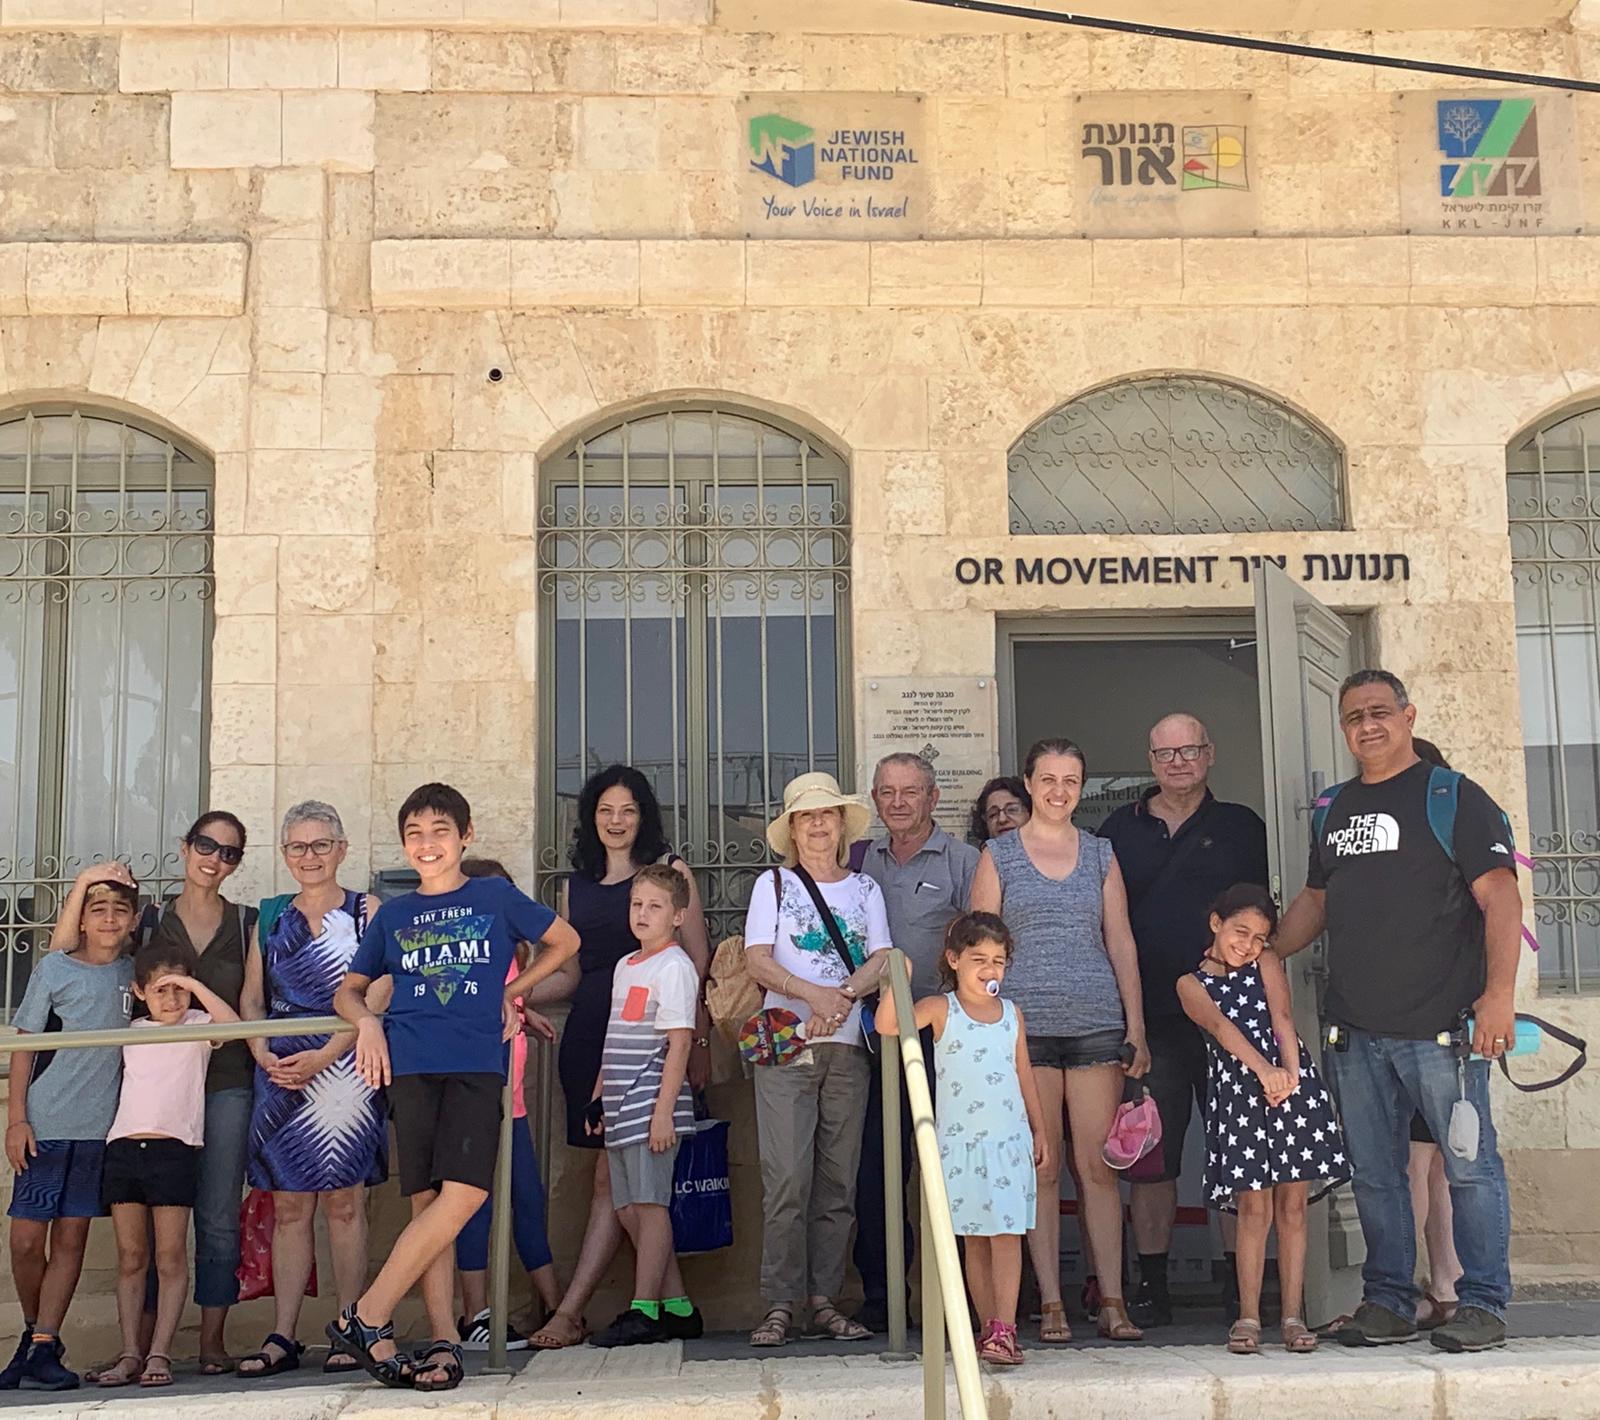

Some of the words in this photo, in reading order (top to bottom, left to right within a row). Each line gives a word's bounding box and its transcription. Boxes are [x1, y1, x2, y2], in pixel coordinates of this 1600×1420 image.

[828, 130, 905, 146] JEWISH
[1082, 122, 1175, 145] תנועת
[820, 147, 919, 163] NATIONAL
[842, 165, 894, 181] FUND
[1082, 146, 1177, 185] אור
[762, 195, 796, 220] Your
[803, 196, 843, 218] Voice
[849, 198, 862, 218] in
[867, 196, 909, 218] Israel
[1441, 201, 1485, 212] לישראל
[1487, 202, 1520, 213] קימת
[1523, 202, 1543, 213] קרן
[955, 556, 1004, 585] OR
[1016, 555, 1219, 585] MOVEMENT
[1302, 553, 1411, 582] תנועת
[1349, 813, 1376, 828] THE
[1326, 827, 1374, 846] NORTH
[1335, 839, 1373, 857] FACE
[413, 913, 436, 925] STAY
[441, 907, 473, 920] FRESH
[401, 939, 490, 971] MIAMI
[414, 983, 426, 997] 19
[463, 980, 478, 995] 76
[675, 1180, 693, 1194] LC
